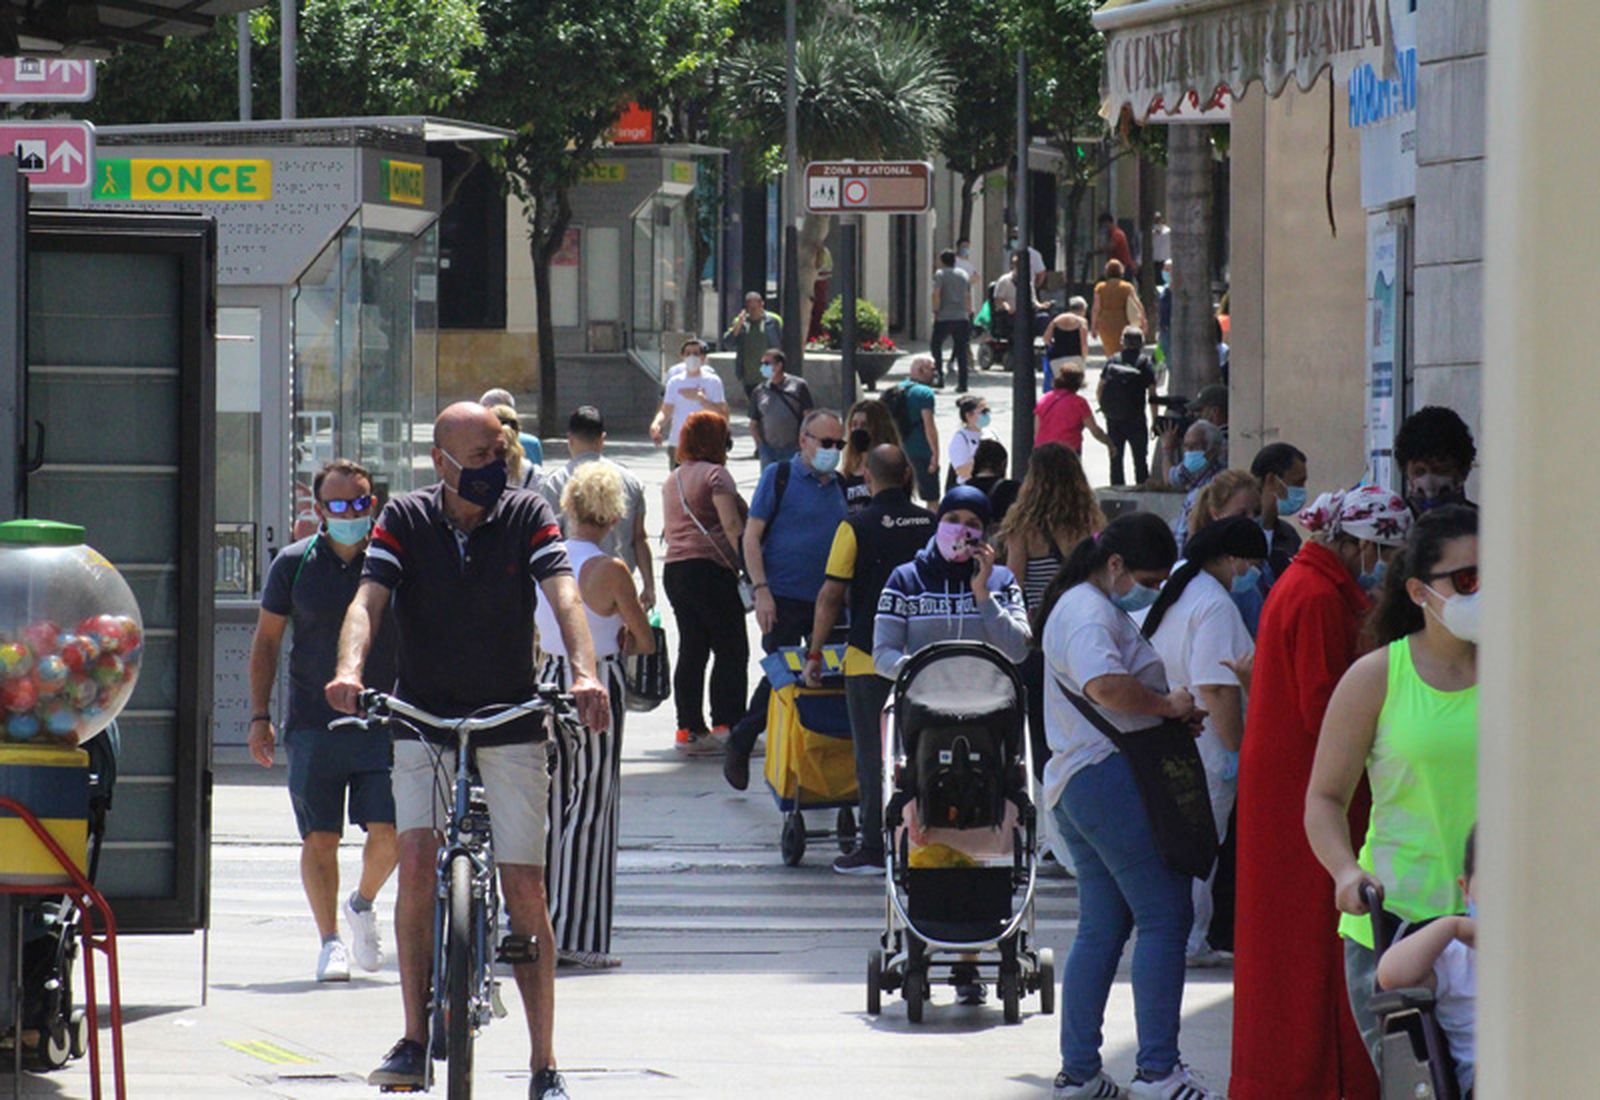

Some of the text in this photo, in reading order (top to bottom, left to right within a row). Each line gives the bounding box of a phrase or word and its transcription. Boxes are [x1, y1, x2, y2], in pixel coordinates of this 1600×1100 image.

[145, 165, 257, 193] ONCE
[823, 165, 912, 176] ZONA PEATONAL
[392, 166, 420, 196] ONCE
[895, 516, 931, 527] Correos
